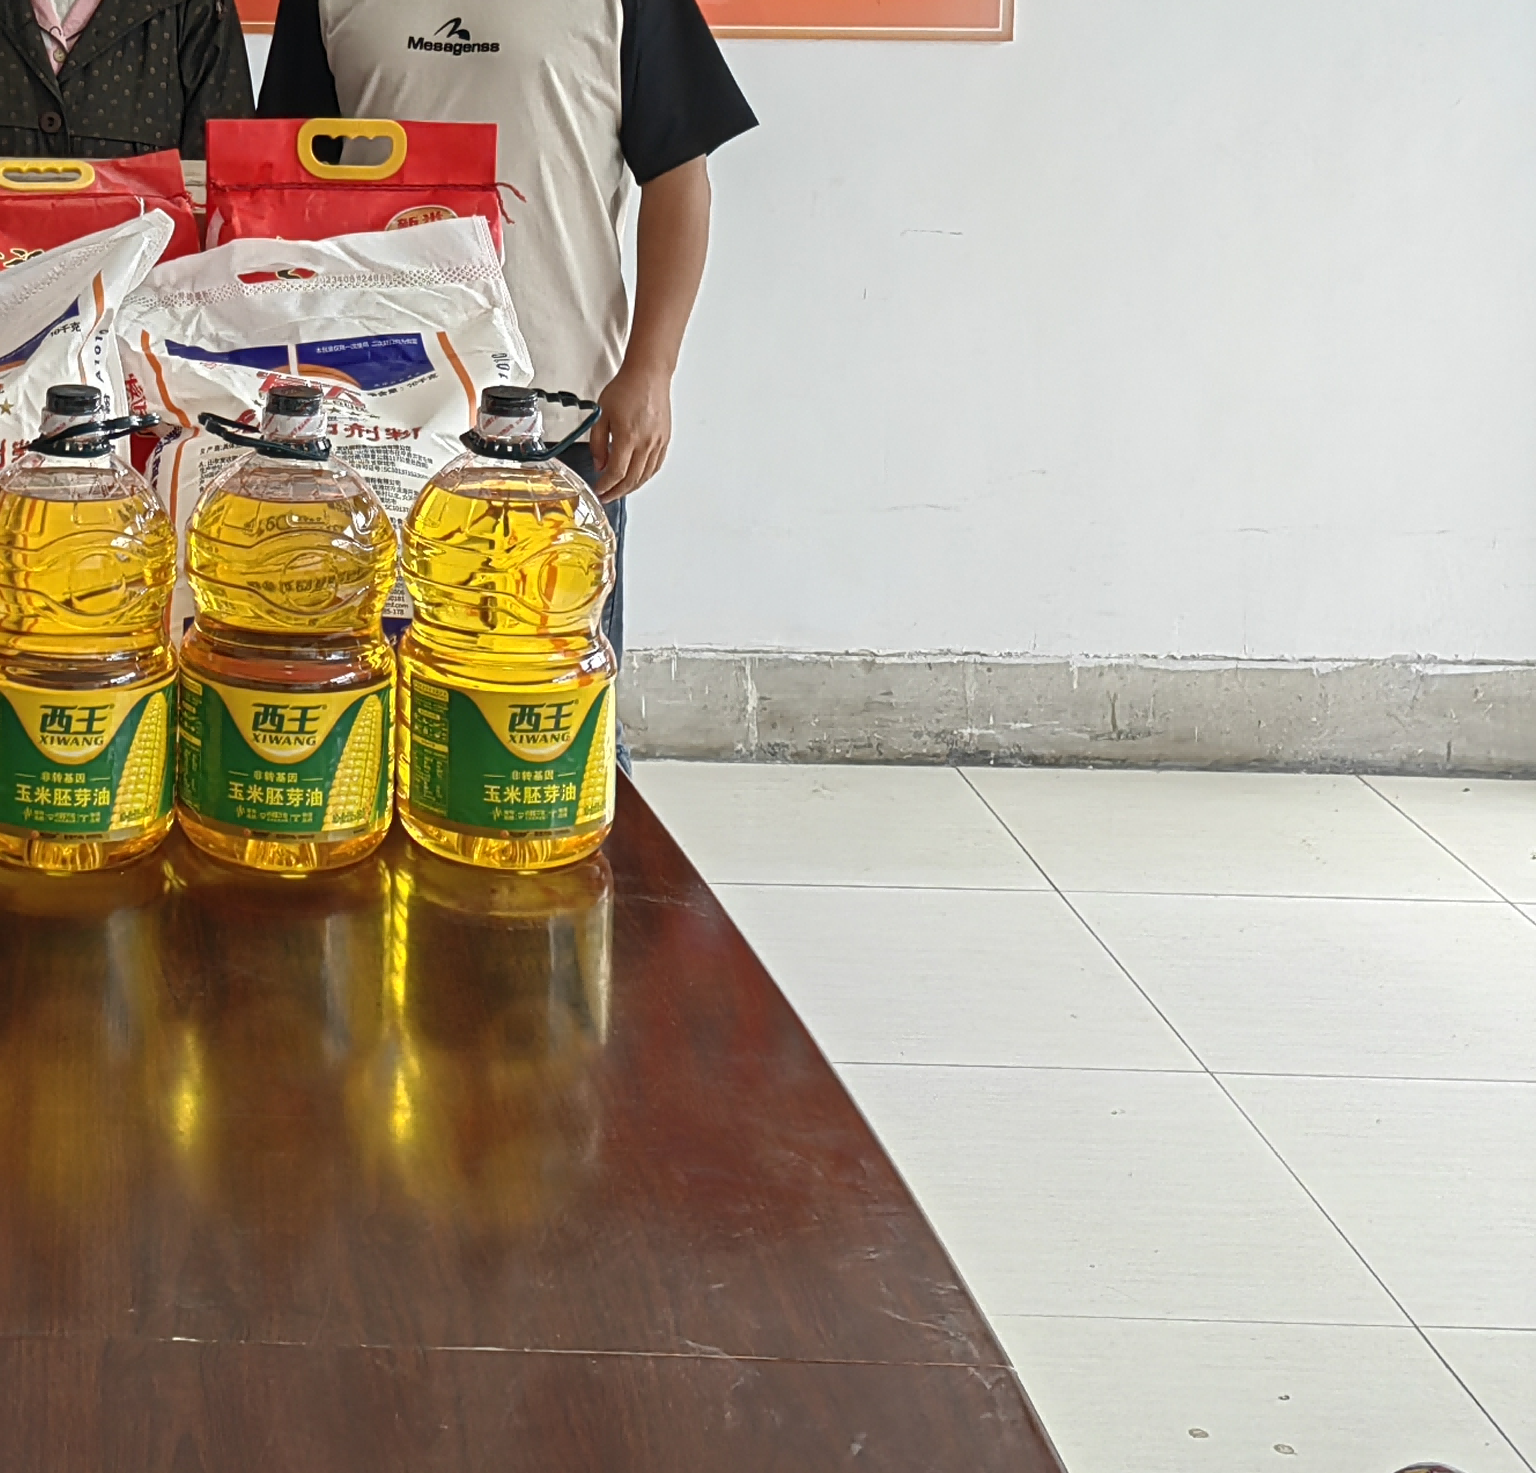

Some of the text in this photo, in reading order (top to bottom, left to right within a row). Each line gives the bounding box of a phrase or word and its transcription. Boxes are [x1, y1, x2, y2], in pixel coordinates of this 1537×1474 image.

[39, 704, 110, 734] 西王
[251, 703, 322, 734] 西王
[507, 702, 576, 734] 西王
[39, 735, 104, 747] XIWANG
[252, 734, 318, 746] XIWANG
[508, 733, 570, 745] XIWANG
[41, 771, 86, 783] 非转基因
[253, 770, 298, 783] 非转基因
[511, 770, 554, 781] 非转基因
[15, 783, 110, 807] 玉米胚芽油
[228, 781, 323, 807] 玉米胚芽油
[483, 782, 577, 804] 玉米胚芽油
